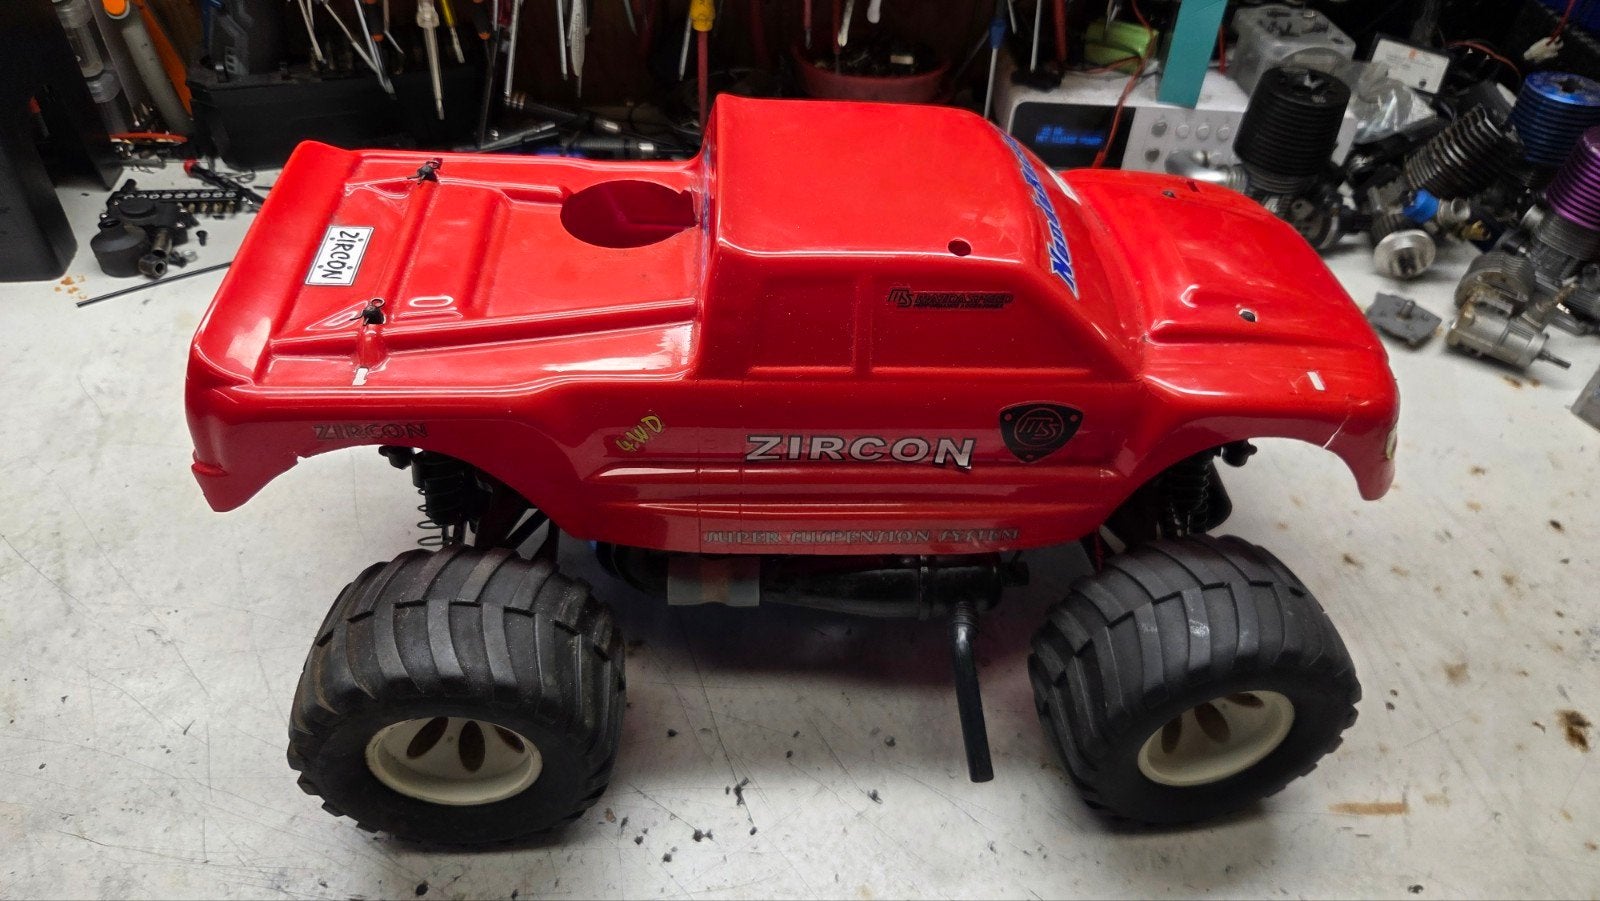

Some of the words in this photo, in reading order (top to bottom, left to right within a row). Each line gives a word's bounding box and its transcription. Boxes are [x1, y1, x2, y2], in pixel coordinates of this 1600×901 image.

[321, 230, 360, 280] ZIRCON
[312, 422, 430, 440] ZIRCON
[615, 415, 663, 452] 4WD
[745, 434, 977, 470] ZIRCON
[705, 530, 780, 544] SUPER
